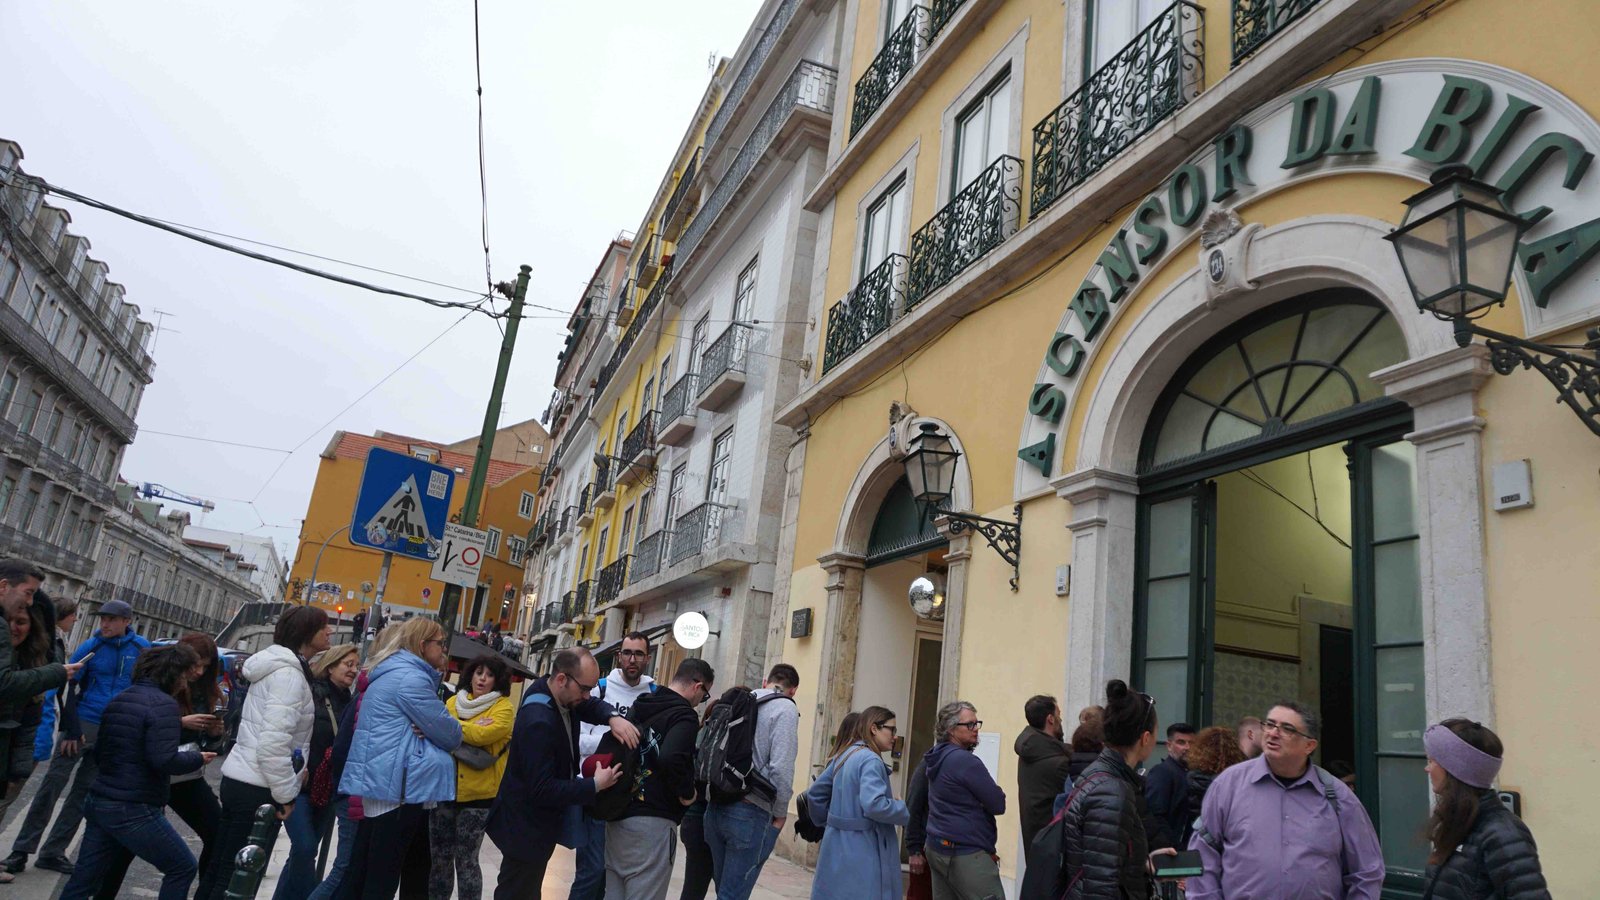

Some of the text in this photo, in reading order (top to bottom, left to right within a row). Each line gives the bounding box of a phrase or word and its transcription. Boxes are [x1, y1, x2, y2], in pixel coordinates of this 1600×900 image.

[1018, 73, 1600, 477] ASCENSOR DA BICA
